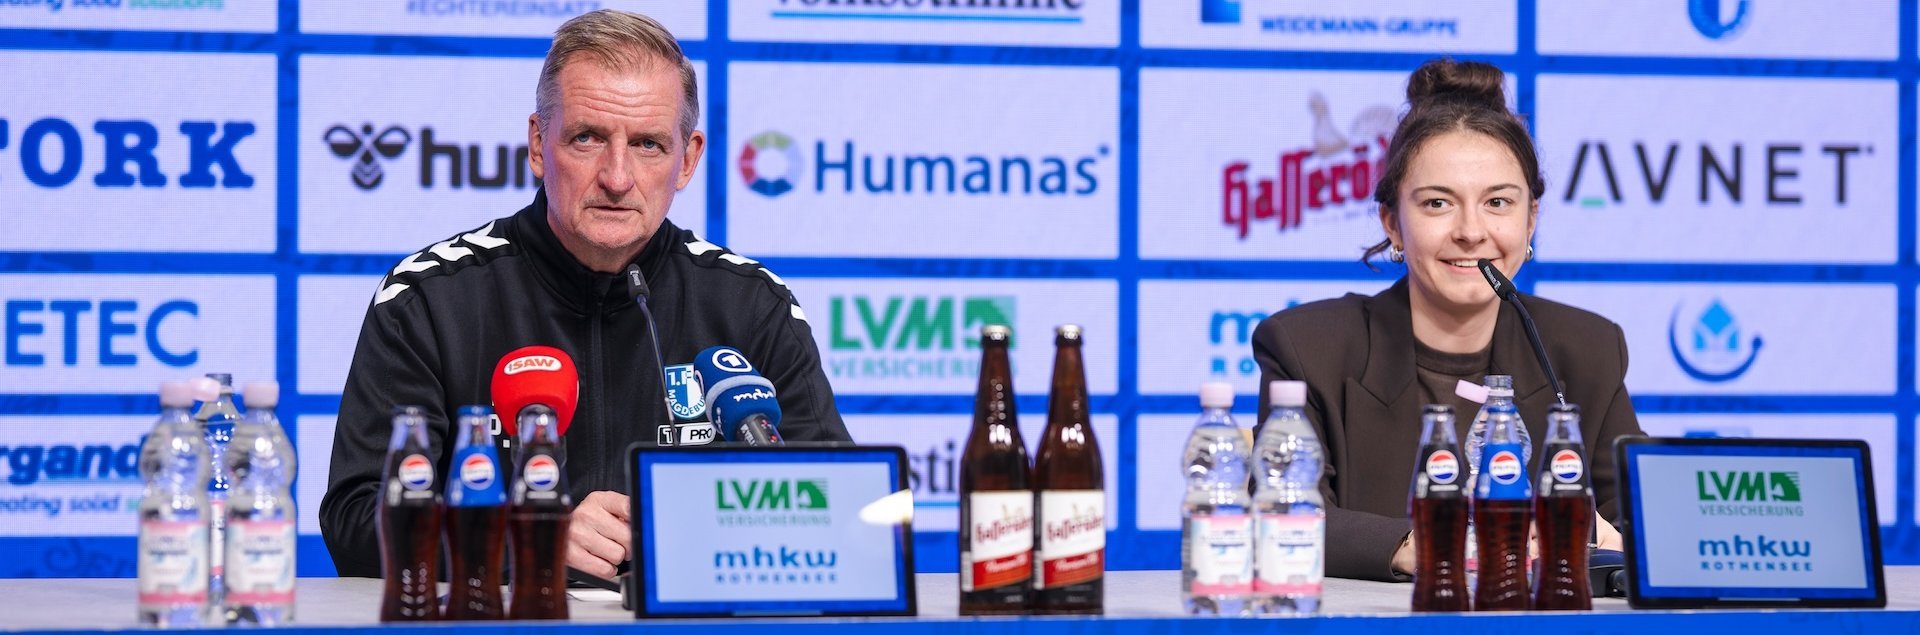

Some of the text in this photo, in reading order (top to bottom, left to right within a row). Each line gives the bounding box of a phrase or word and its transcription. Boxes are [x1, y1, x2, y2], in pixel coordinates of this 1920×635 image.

[0, 117, 256, 189] ORK
[815, 139, 1099, 195] Humanas
[1563, 142, 1862, 205] AVNET
[5, 299, 199, 367] ETEC
[829, 296, 956, 351] LVM
[513, 358, 555, 370] SAW
[717, 480, 790, 509] LVM
[1697, 471, 1767, 501] LVM
[1700, 505, 1804, 516] VERSICHERUNG
[715, 546, 837, 567] mhkw
[1699, 535, 1811, 557] mhkw
[1701, 561, 1812, 572] ROTHENSEE
